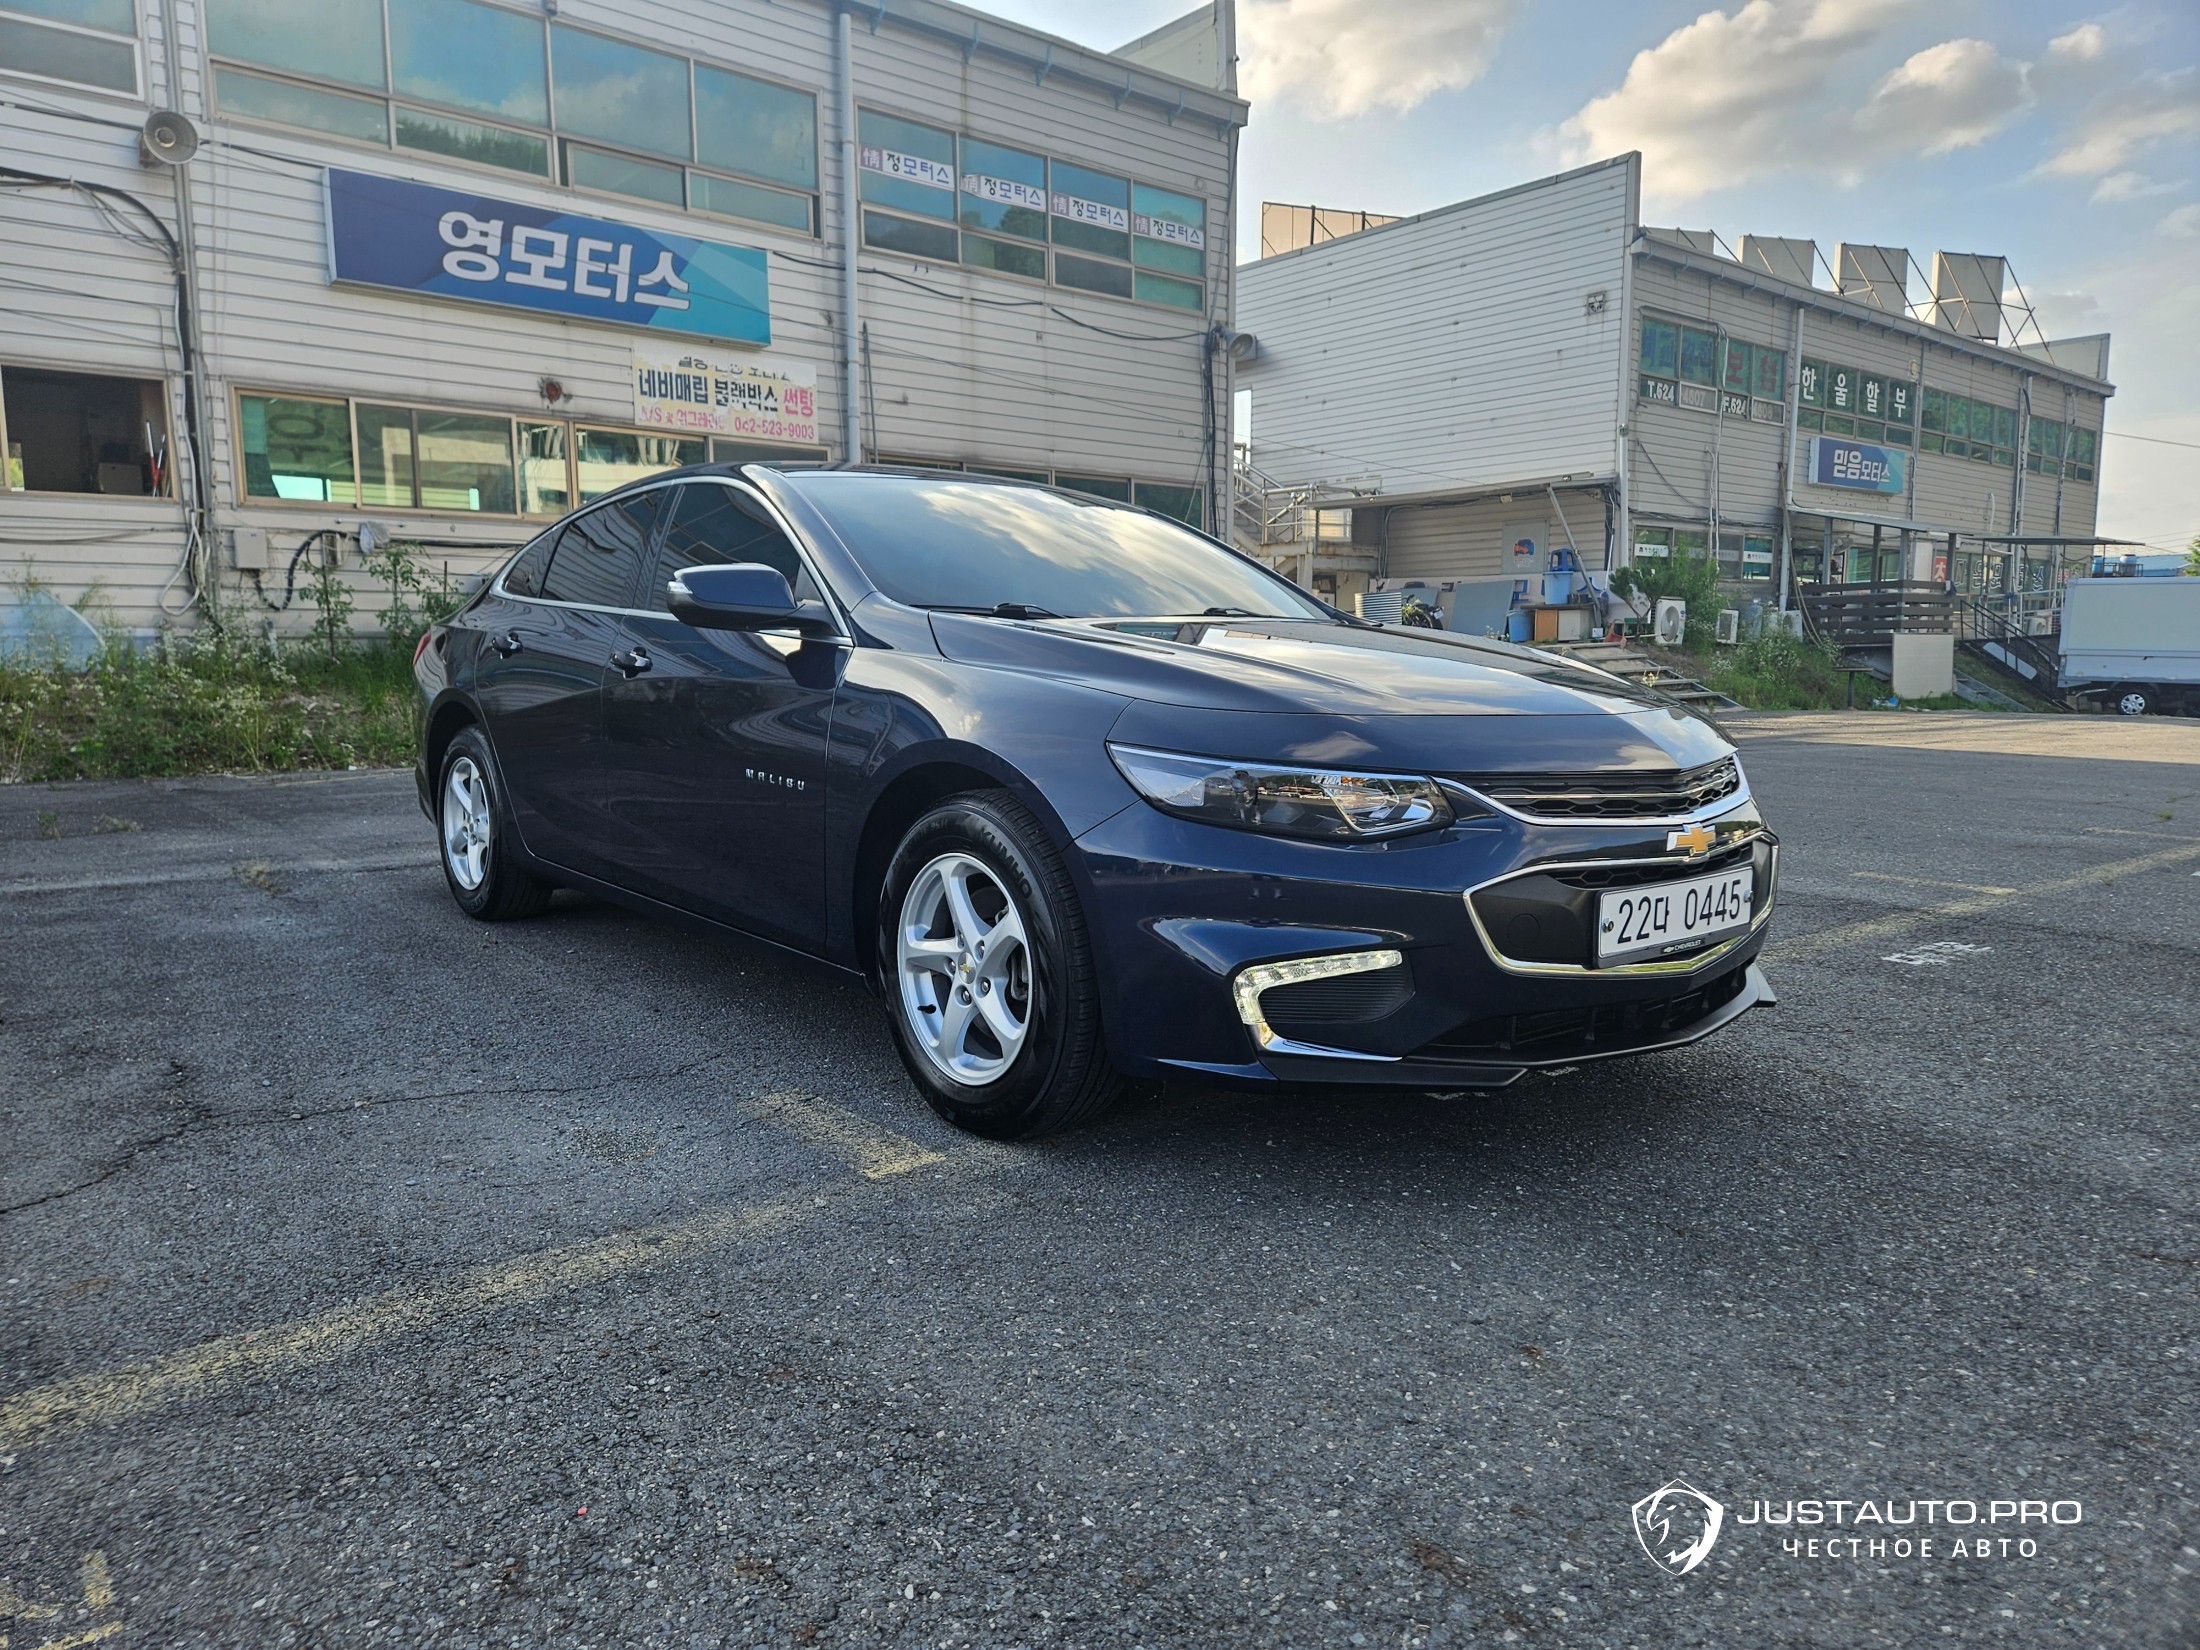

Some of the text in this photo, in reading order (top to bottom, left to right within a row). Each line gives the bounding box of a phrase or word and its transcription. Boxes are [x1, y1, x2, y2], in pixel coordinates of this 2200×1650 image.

[886, 153, 950, 184] 정모터스
[984, 177, 1041, 206] 정모터스
[1073, 200, 1124, 227] 정모터스
[1153, 220, 1200, 245] 정모터스
[438, 210, 691, 311] 영모터스
[639, 368, 709, 405] 네비매립
[783, 386, 815, 418] 썬팅
[1647, 380, 1675, 402] T.524
[1802, 366, 1906, 418] 한울할부
[1833, 449, 1891, 483] 믿음모터스
[745, 768, 804, 791] MALIBU
[1617, 879, 1741, 944] 22다 0445
